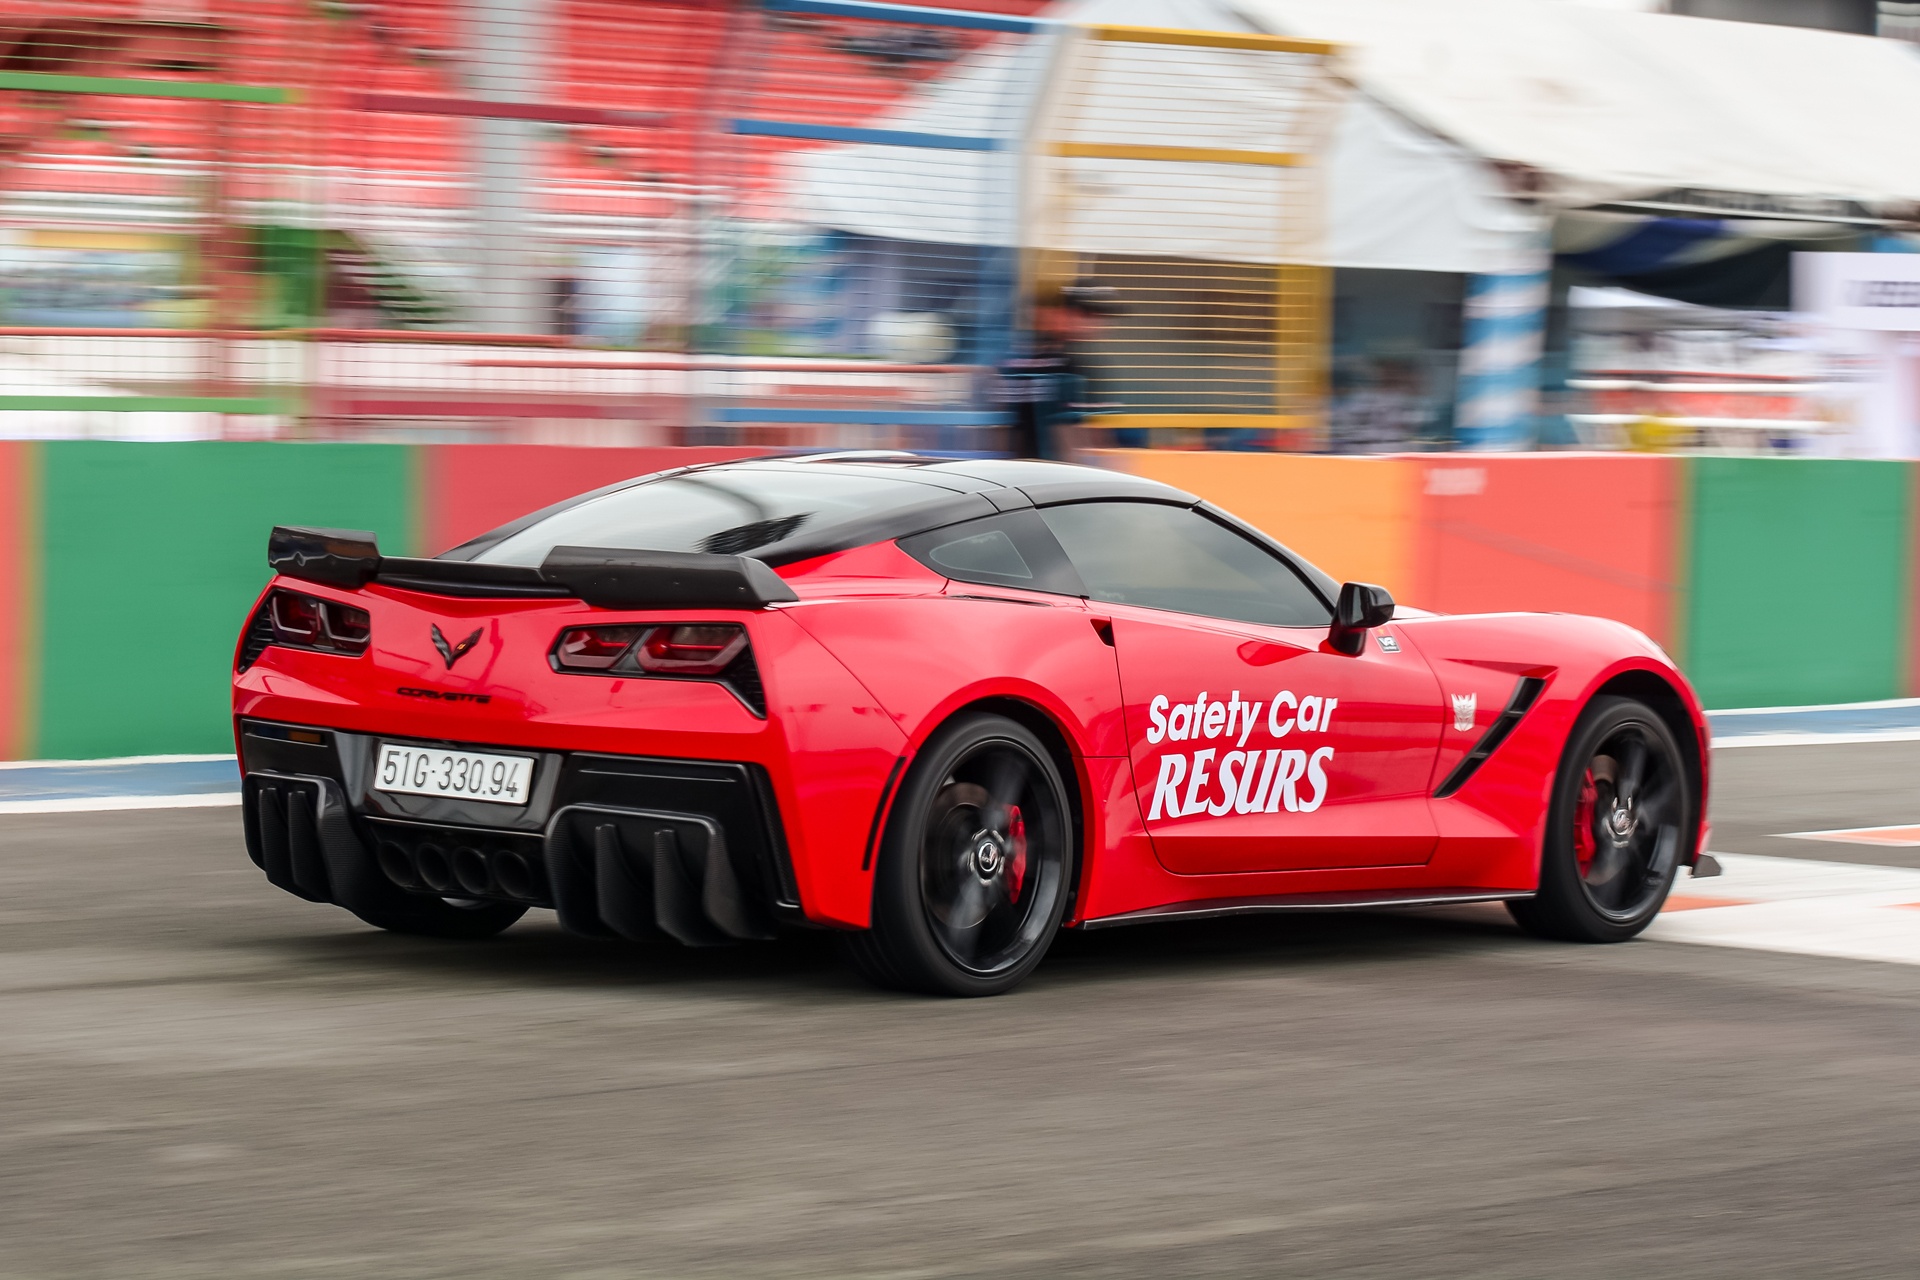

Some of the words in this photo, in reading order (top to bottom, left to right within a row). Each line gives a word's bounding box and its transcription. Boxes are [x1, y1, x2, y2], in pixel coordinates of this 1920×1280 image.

[397, 687, 492, 703] CORVETTE
[1147, 690, 1263, 747] Safety
[1268, 690, 1338, 738] Car
[1147, 746, 1335, 821] RESURS
